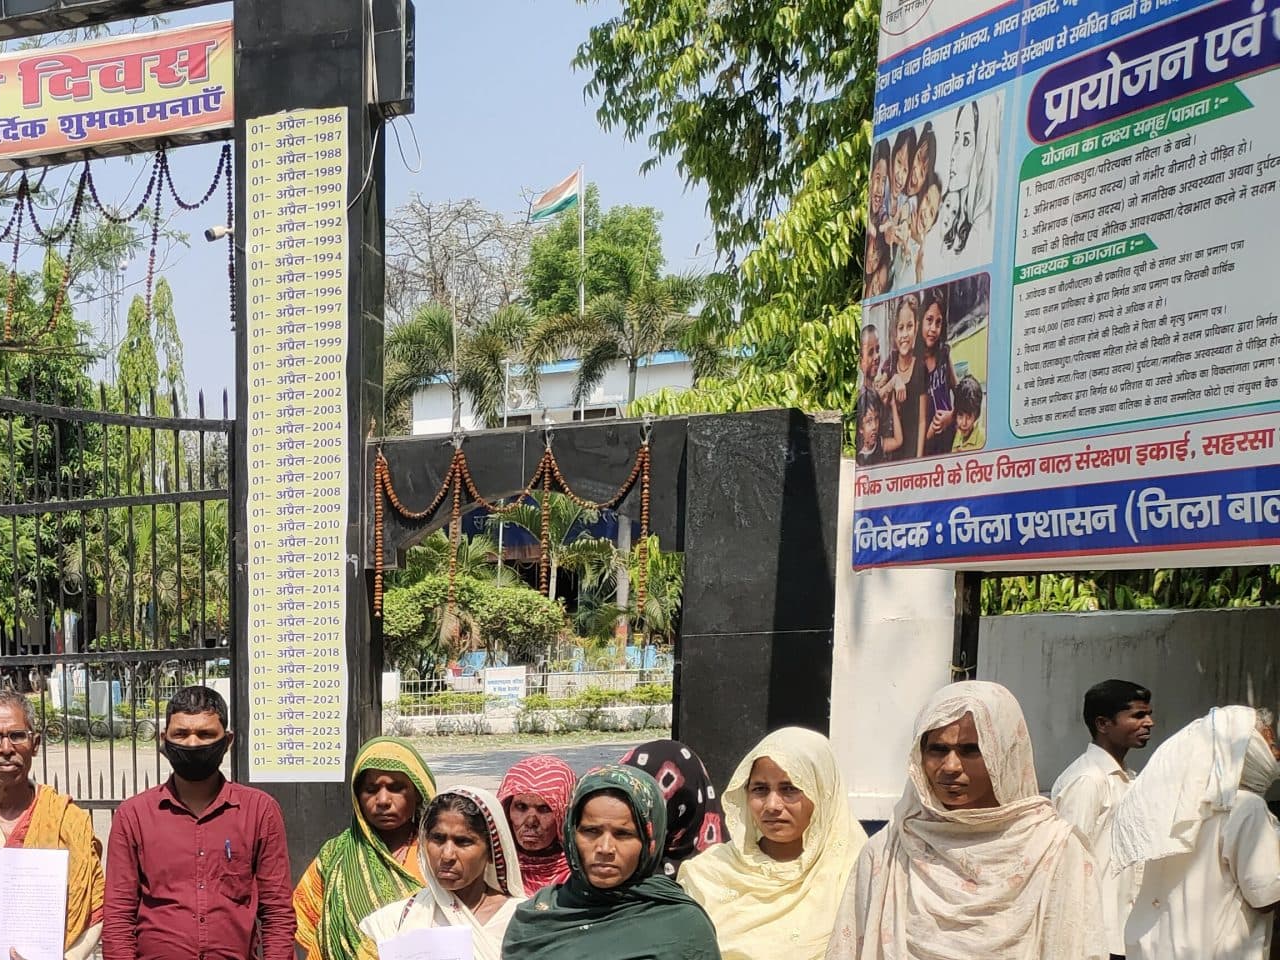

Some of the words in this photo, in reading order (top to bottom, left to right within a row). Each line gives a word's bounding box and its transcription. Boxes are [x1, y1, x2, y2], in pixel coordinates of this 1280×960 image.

[892, 60, 902, 84] एवं
[904, 58, 921, 76] बाल
[922, 47, 950, 69] विकास
[953, 27, 989, 54] मंत्रालय,
[994, 15, 1018, 37] भारत
[1022, 0, 1059, 24] सरकार,
[18, 40, 218, 108] दिवस
[904, 94, 919, 113] 2015
[921, 84, 930, 104] के
[932, 74, 965, 100] आलोक
[967, 63, 975, 85] में
[978, 50, 1017, 80] देख-रेख
[1021, 40, 1054, 63] संरक्षण
[1057, 26, 1066, 49] से
[1070, 12, 1108, 44] संबंधित
[1044, 36, 1198, 137] प्रायोजन
[1204, 0, 1266, 72] एवं
[251, 125, 271, 135] 01-
[276, 113, 342, 131] अप्रैल-1986
[1041, 142, 1080, 166] योजना
[1082, 136, 1099, 152] का
[1102, 130, 1129, 147] लक्ष्य
[1133, 98, 1211, 139] समूह/पात्रता
[252, 176, 271, 186] 01-
[276, 166, 342, 183] अप्रैल-1989
[1024, 209, 1031, 218] 2.
[1033, 196, 1070, 216] अभिभावक
[1100, 178, 1126, 195] सदस्य)
[1130, 171, 1140, 186] जो
[1143, 165, 1165, 182] गंभीर
[1168, 154, 1196, 174] बीमारी
[1199, 151, 1206, 165] से
[1211, 145, 1235, 162] पीड़ित
[1026, 187, 1031, 197] 1.
[1135, 146, 1161, 162] महिला
[1164, 139, 1172, 153] के
[1023, 230, 1027, 238] 3.
[1032, 217, 1068, 236] अभिभावक
[1098, 199, 1124, 217] सदस्य)
[1128, 193, 1138, 208] जो
[1141, 185, 1176, 203] मानसिक
[1228, 164, 1253, 179] अथवा
[1050, 237, 1059, 249] की
[1062, 231, 1084, 247] वित्तीय
[1102, 221, 1127, 237] भौतिक
[1215, 188, 1236, 205] करने
[1239, 185, 1247, 199] में
[1251, 181, 1276, 197] सक्षम
[252, 228, 271, 237] 01-
[276, 217, 342, 234] अप्रैल-1992
[1020, 257, 1070, 279] आवश्यक
[1073, 241, 1126, 265] कागजात
[1105, 266, 1131, 282] प्रकाशित
[1150, 258, 1156, 270] के
[1195, 250, 1204, 259] का
[1207, 244, 1228, 256] प्रमाण
[252, 278, 271, 287] 01-
[276, 268, 342, 284] अप्रैल-1995
[253, 328, 271, 338] 01-
[276, 320, 342, 335] अप्रैल-1998
[1142, 318, 1156, 330] पिता
[1159, 314, 1167, 327] की
[1188, 309, 1208, 321] प्रमाण
[254, 378, 272, 387] 01-
[277, 370, 341, 386] अप्रैल-2001
[252, 427, 271, 437] 01-
[275, 422, 341, 436] अप्रैल-2004
[855, 475, 882, 497] धिक
[886, 464, 945, 492] जानकारी
[948, 462, 963, 486] के
[966, 459, 994, 484] लिए
[997, 455, 1036, 480] जिला
[1039, 453, 1074, 473] बाल
[1075, 444, 1132, 471] संरक्षण
[1136, 431, 1196, 466] इकाई,
[1202, 428, 1275, 456] सहरसा
[254, 524, 272, 533] 01-
[277, 519, 340, 533] अप्रैल-2010
[854, 515, 931, 553] निवेदक
[949, 506, 1012, 545] जिला
[1016, 504, 1117, 546] प्रशासन
[1124, 487, 1221, 543] (जिला
[254, 619, 272, 628] 01-
[277, 615, 340, 628] अप्रैल-2016
[254, 666, 273, 675] 01-
[277, 663, 340, 675] अप्रैल-2019
[254, 713, 272, 721] 01-
[277, 709, 340, 722] अप्रैल-2022
[254, 757, 273, 766] 01-
[277, 754, 340, 767] अप्रैल-2025
